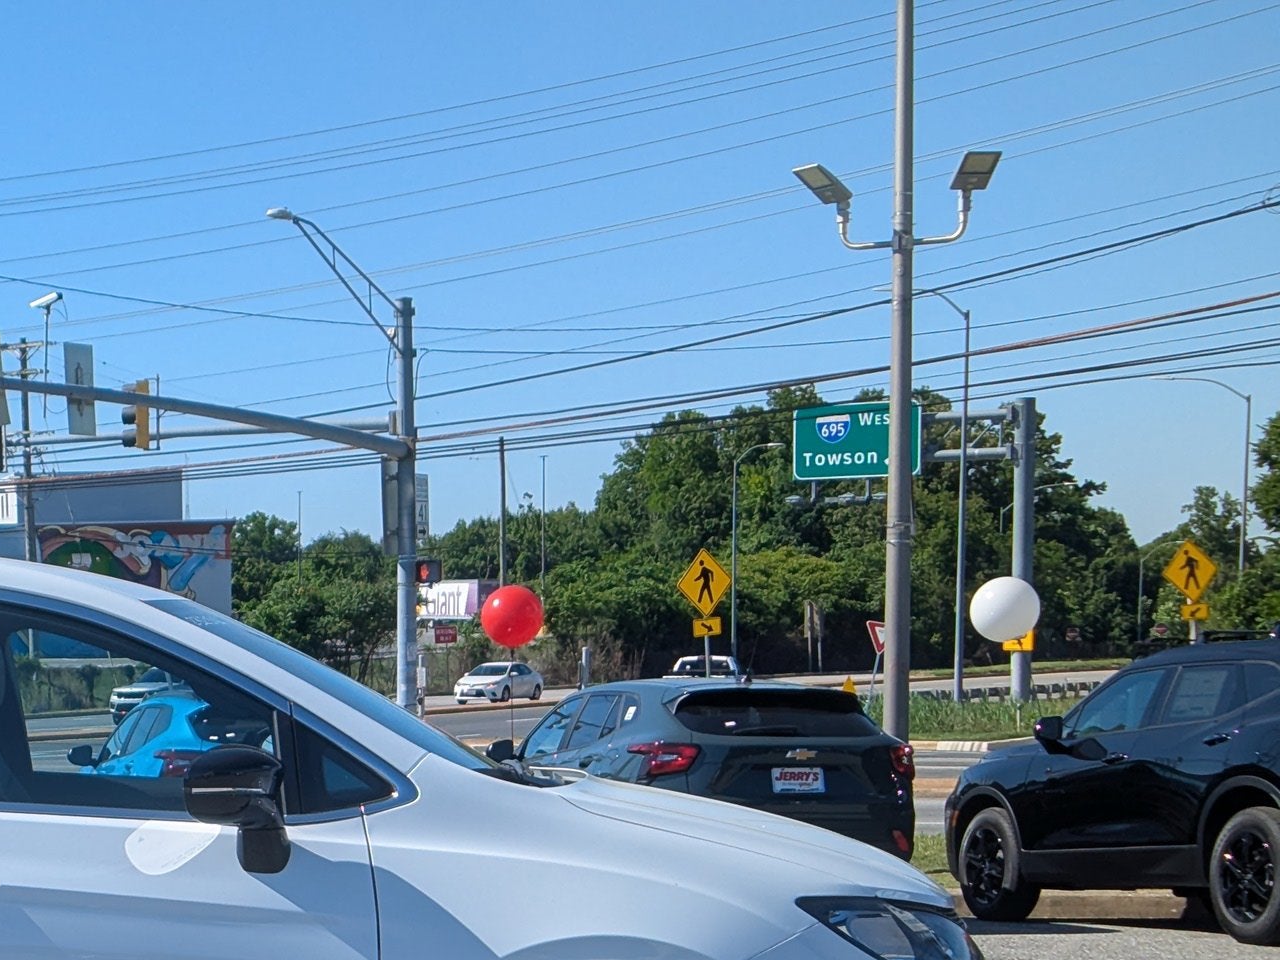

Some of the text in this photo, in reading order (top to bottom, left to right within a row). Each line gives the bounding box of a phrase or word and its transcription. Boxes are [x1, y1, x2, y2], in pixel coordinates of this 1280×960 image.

[858, 412, 890, 426] WES
[821, 423, 845, 438] 695
[774, 771, 820, 782] JERRY'S
